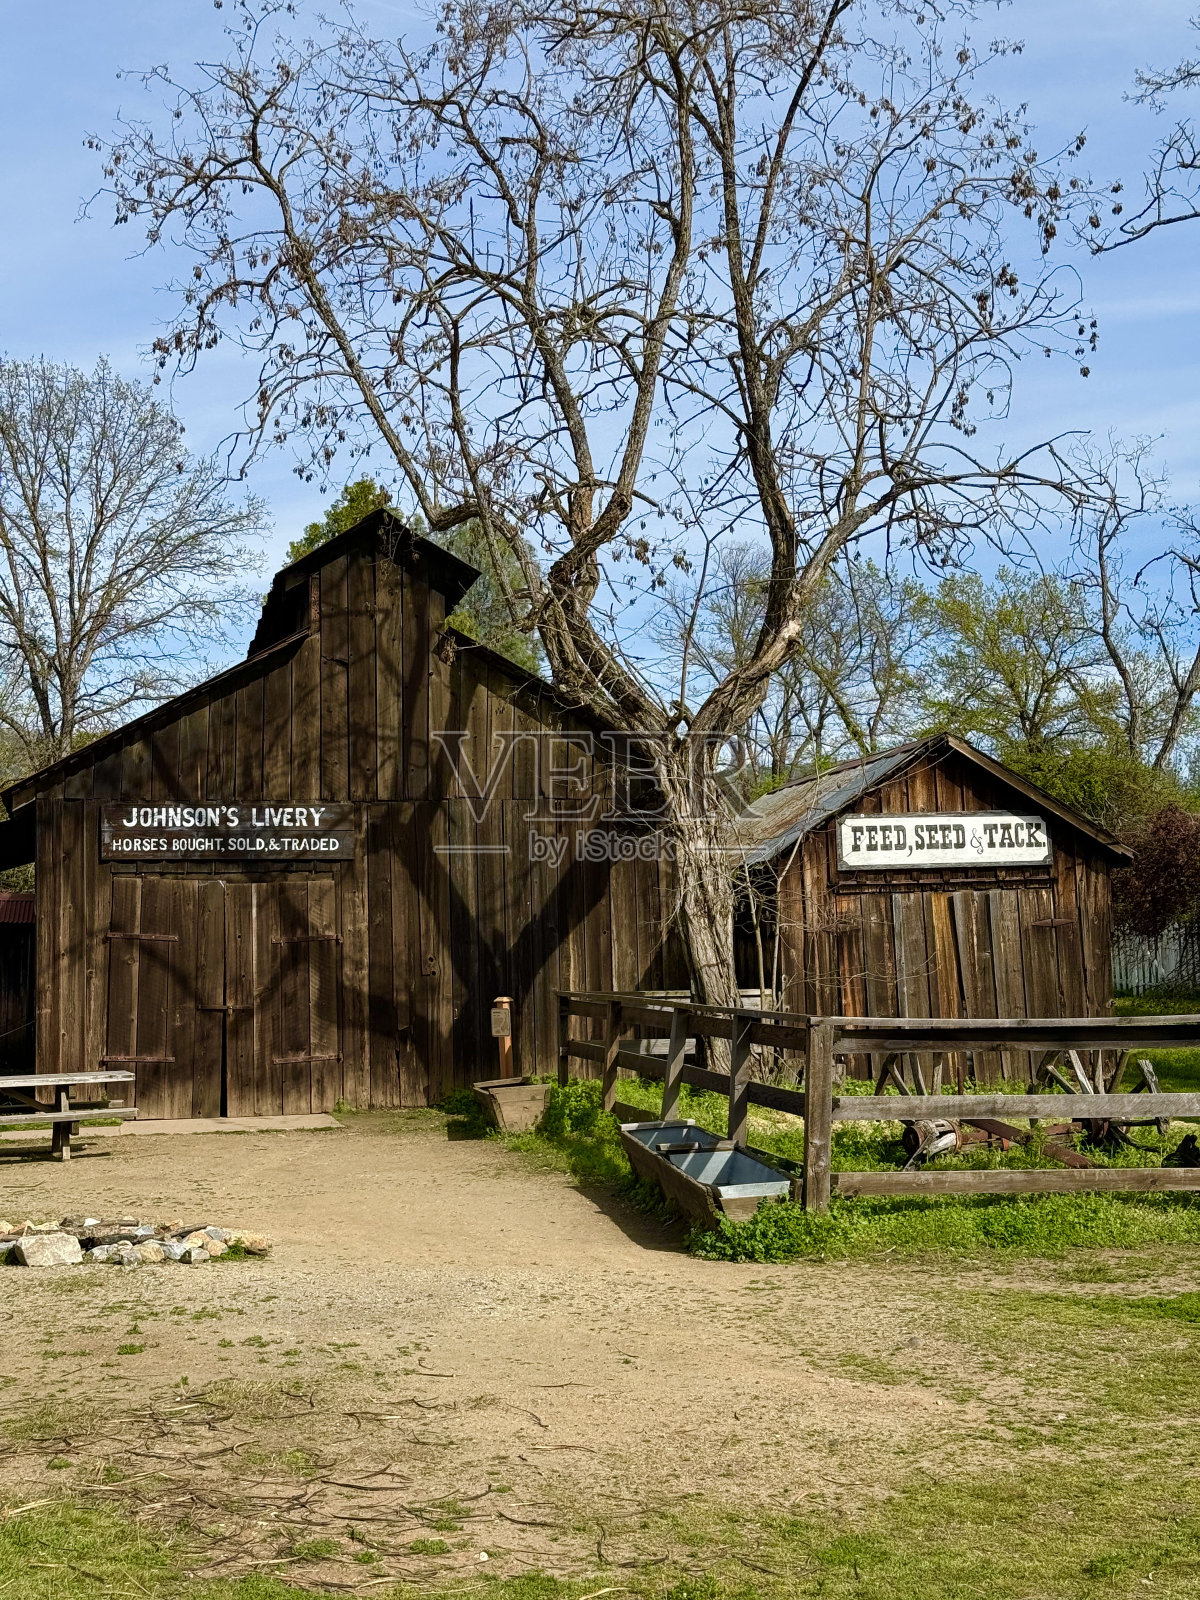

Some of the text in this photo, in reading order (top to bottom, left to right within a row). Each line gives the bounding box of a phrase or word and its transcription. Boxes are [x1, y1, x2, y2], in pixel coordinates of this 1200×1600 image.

[122, 805, 326, 828] JOHNSON'S LIVERY
[112, 838, 168, 851] HORSES
[280, 838, 340, 851] TRADED
[851, 824, 913, 858] FEED,
[914, 823, 967, 851] SEED
[969, 827, 984, 855] &
